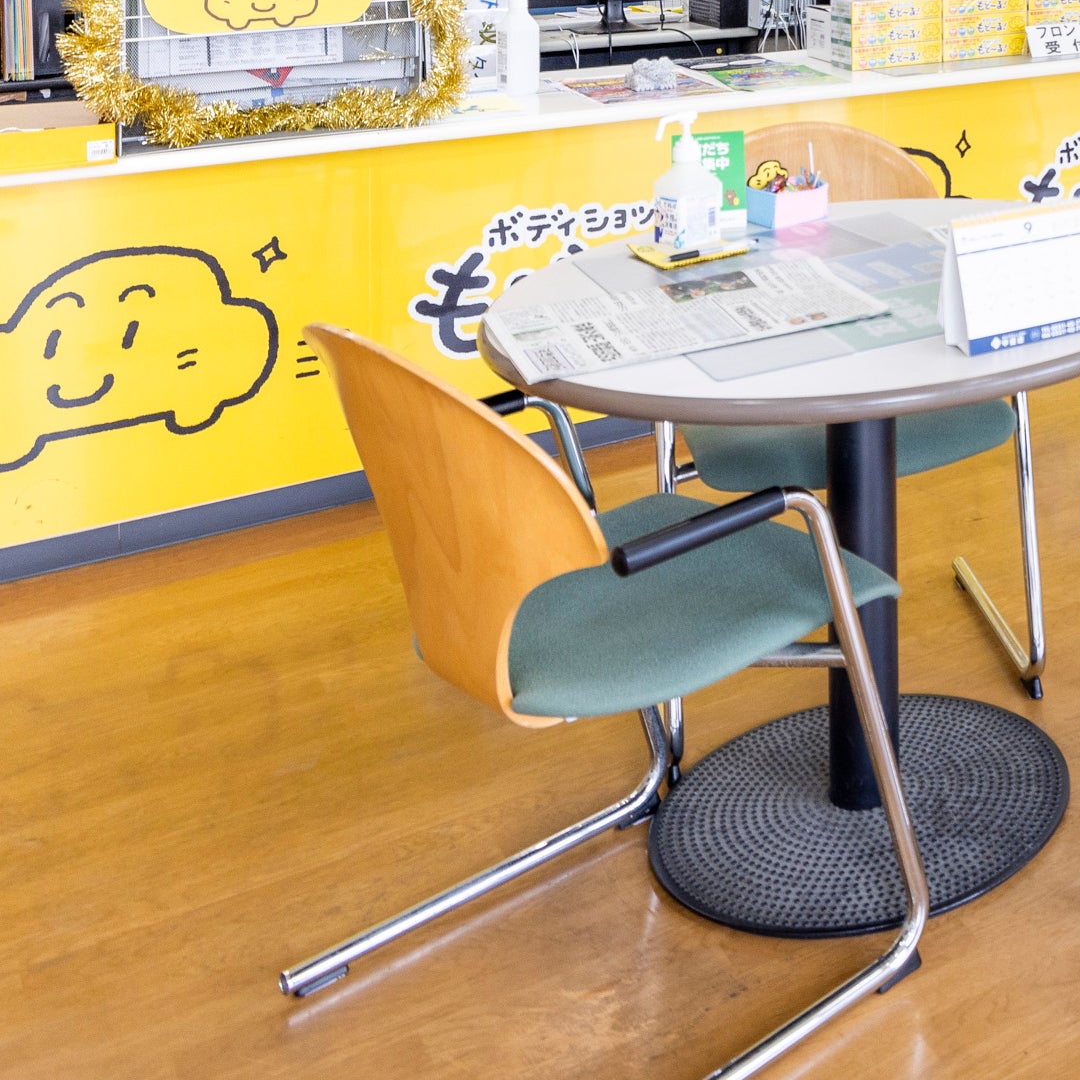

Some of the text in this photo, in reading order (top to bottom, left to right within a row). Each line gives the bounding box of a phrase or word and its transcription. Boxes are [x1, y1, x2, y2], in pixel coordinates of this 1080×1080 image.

[700, 141, 730, 157] だち
[701, 156, 730, 171] 集中
[489, 205, 656, 247] ボディショッ
[1023, 221, 1032, 233] 9
